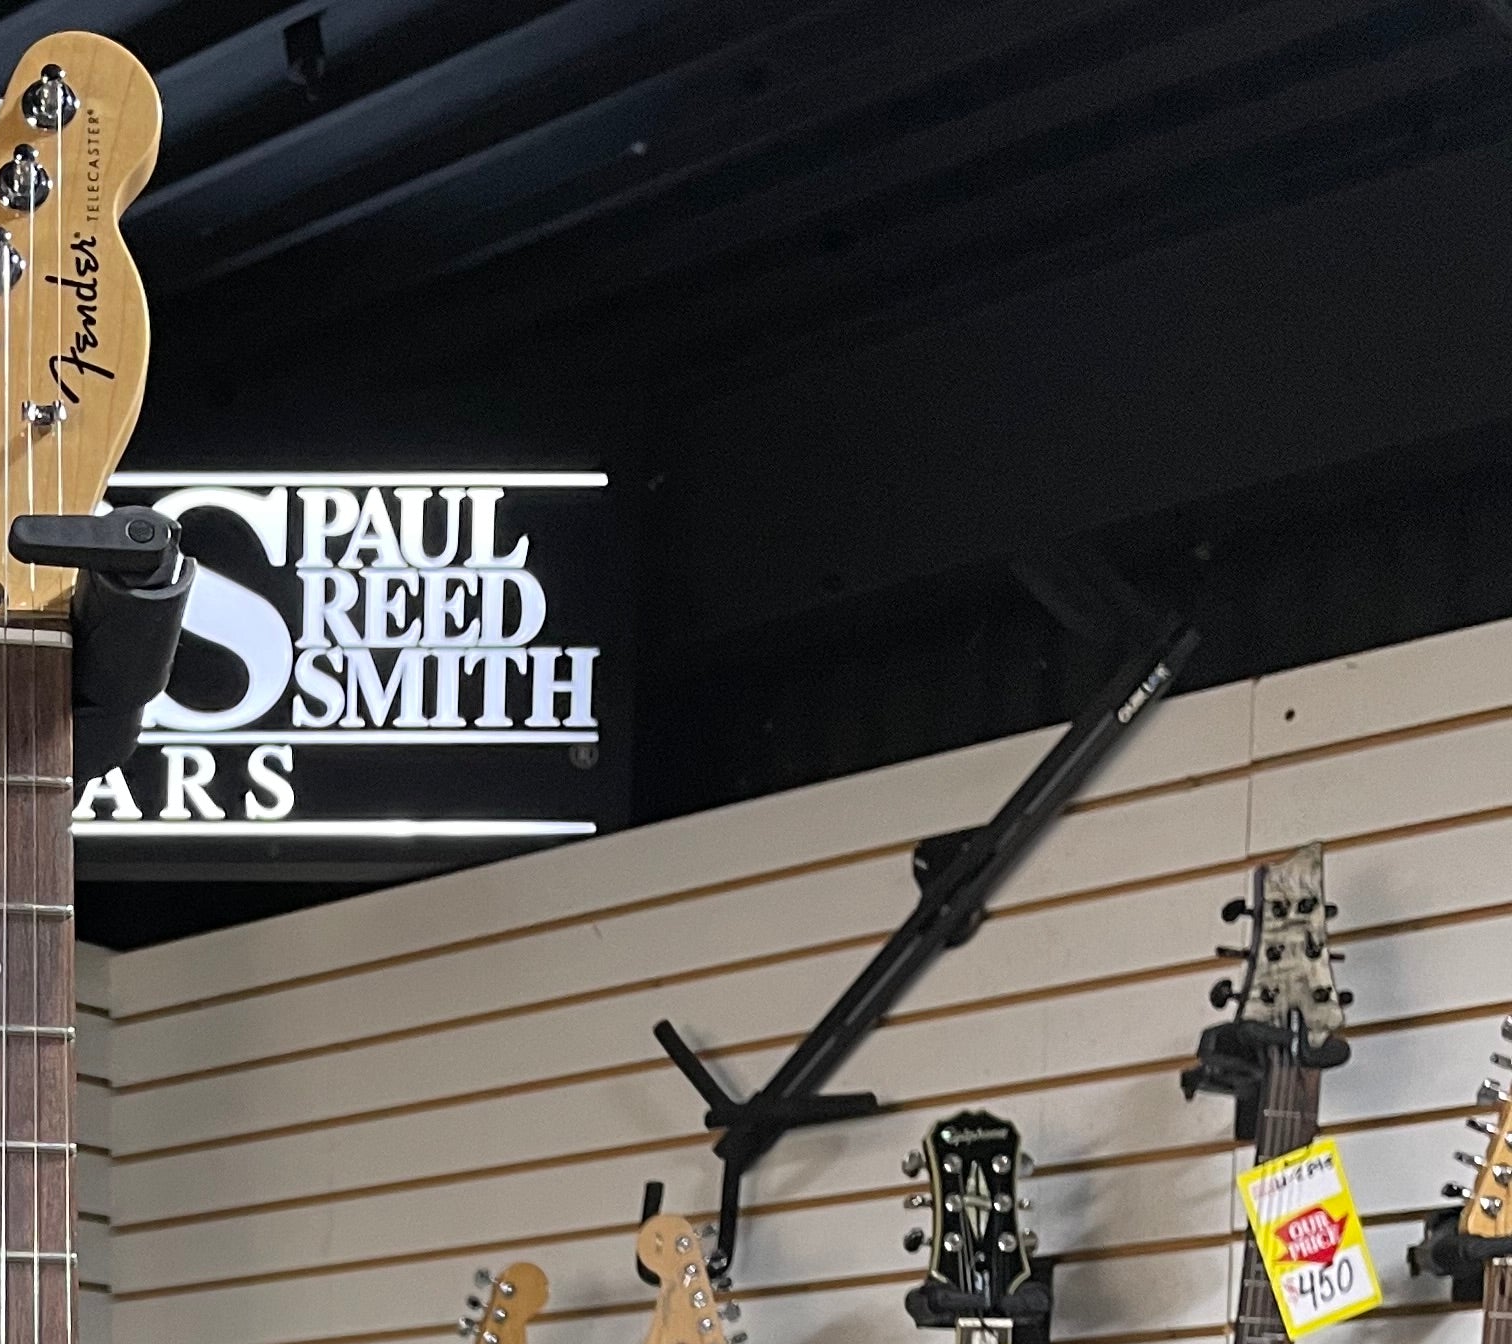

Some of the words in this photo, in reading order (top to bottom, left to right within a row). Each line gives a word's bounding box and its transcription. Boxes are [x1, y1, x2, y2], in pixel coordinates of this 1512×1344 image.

[86, 112, 100, 223] TELECASTER
[45, 235, 116, 404] Fender
[294, 485, 530, 569] PAUL
[294, 567, 547, 648] REED
[291, 645, 601, 729] SMITH
[1287, 1223, 1338, 1262] PRICE
[1289, 1209, 1328, 1241] OUR
